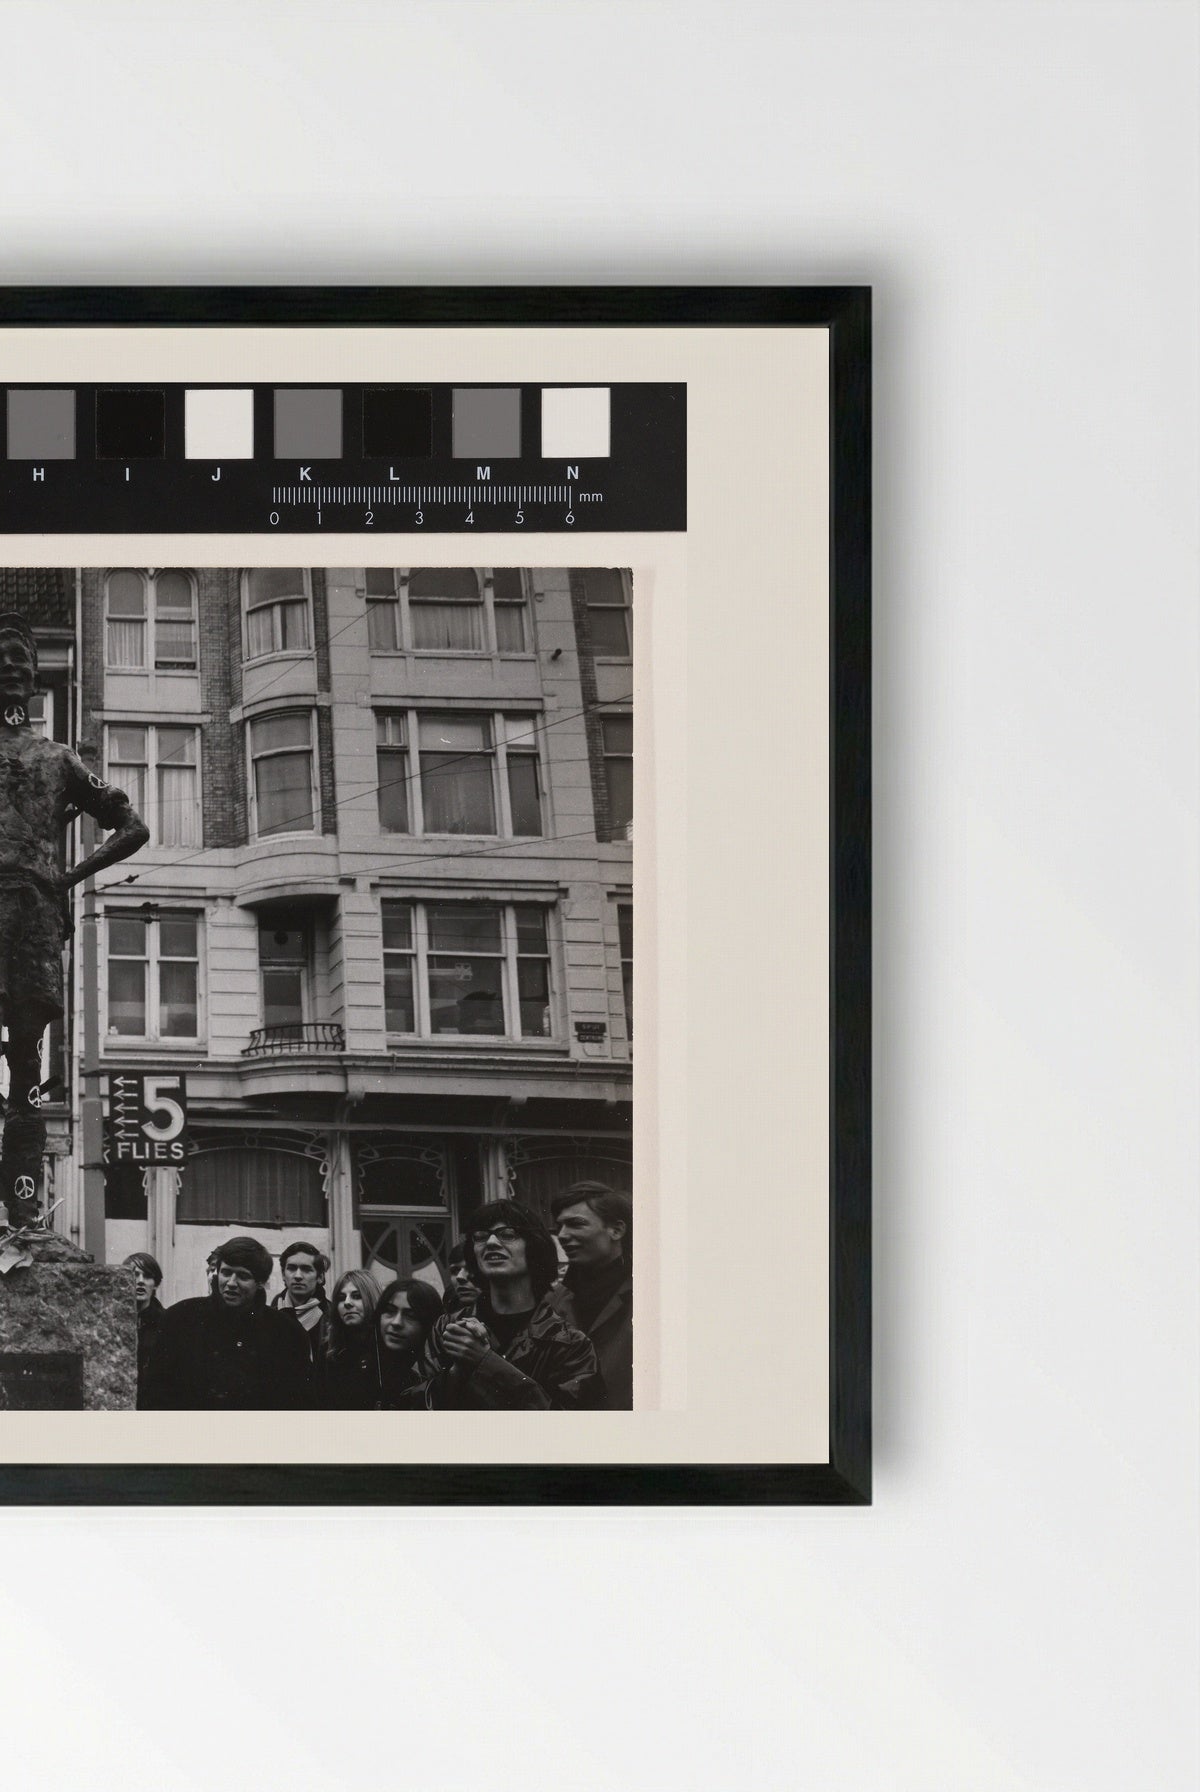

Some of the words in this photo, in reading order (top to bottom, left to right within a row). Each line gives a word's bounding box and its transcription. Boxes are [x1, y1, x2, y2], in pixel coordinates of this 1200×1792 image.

[33, 468, 45, 481] H
[125, 468, 130, 481] I
[211, 468, 221, 481] J
[300, 467, 312, 481] K
[389, 467, 400, 481] L
[476, 467, 491, 480] M
[567, 466, 579, 480] N
[579, 492, 603, 503] mm
[269, 511, 280, 525] 0
[365, 511, 374, 525] 2
[415, 511, 424, 525] 3
[465, 511, 475, 525] 4
[515, 510, 524, 525] 5
[565, 510, 575, 524] 6
[141, 1076, 185, 1141] 5
[117, 1142, 184, 1160] FLIES
